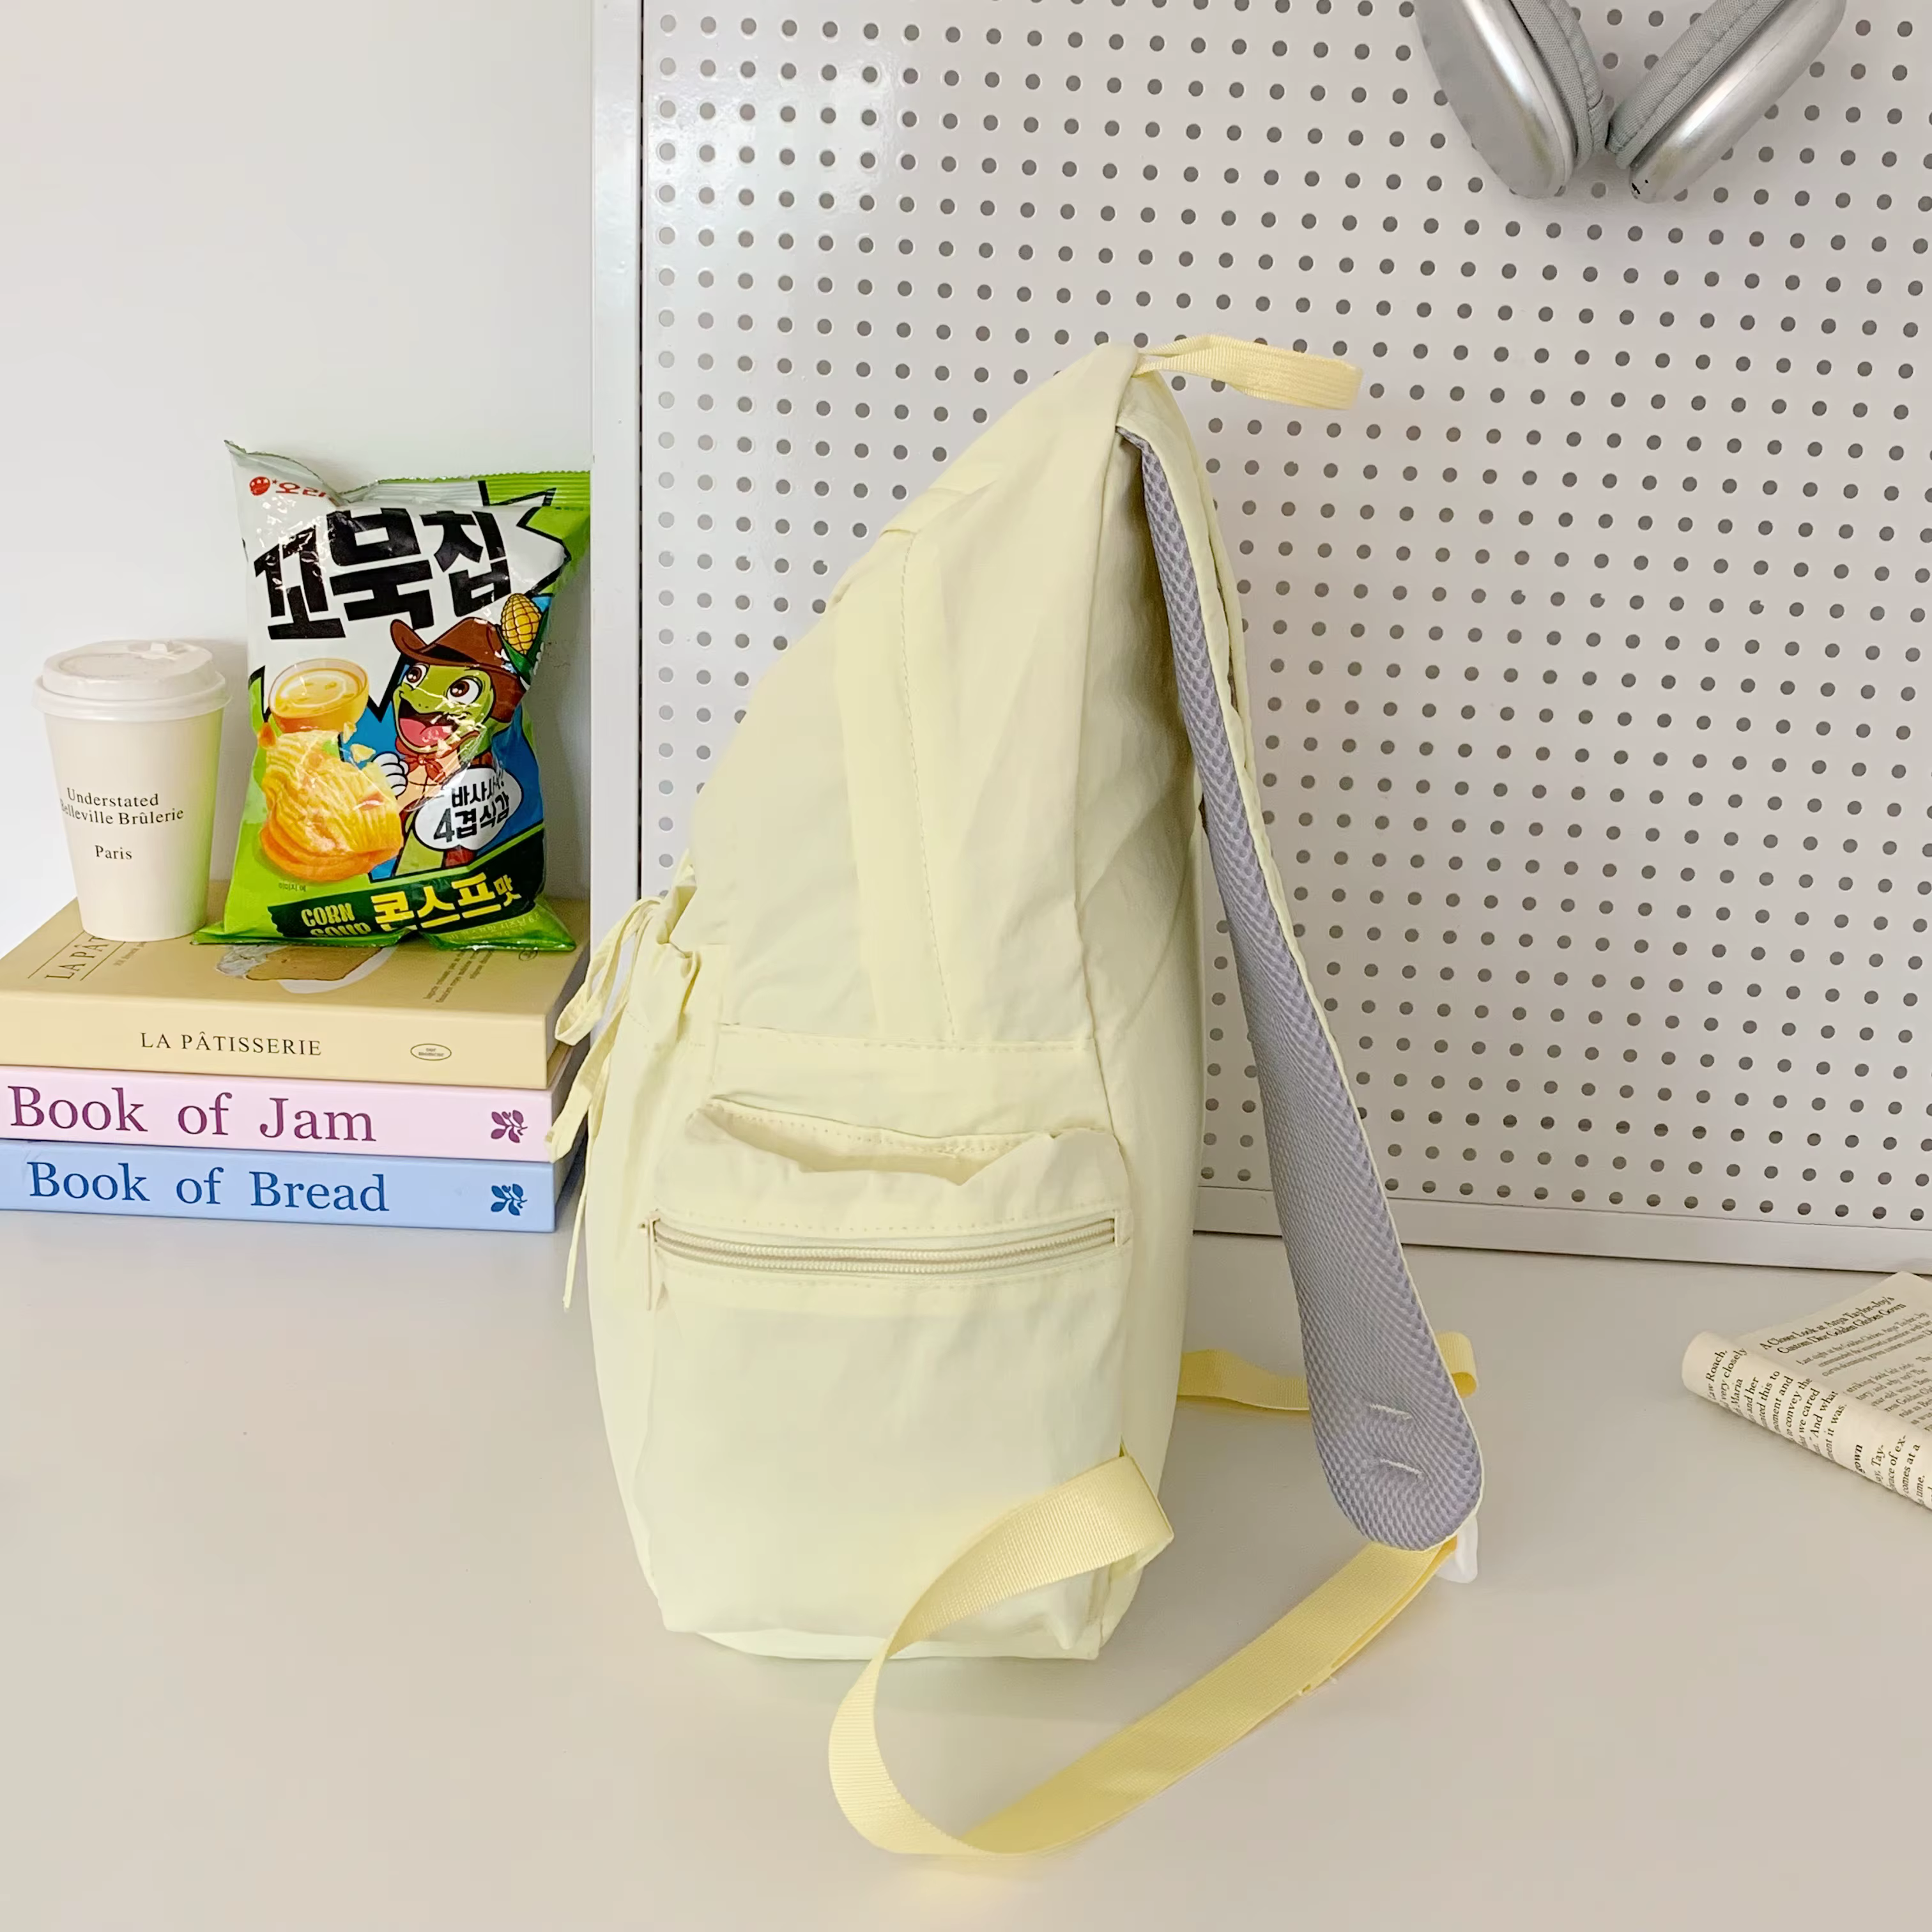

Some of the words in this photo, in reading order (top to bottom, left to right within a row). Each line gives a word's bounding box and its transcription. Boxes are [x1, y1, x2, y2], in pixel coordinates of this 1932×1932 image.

[254, 508, 512, 640] 꼬북칩
[66, 786, 159, 808] Understated
[118, 808, 184, 825] Brûlerie
[95, 845, 132, 860] Paris
[301, 903, 355, 927] CORN
[44, 963, 86, 979] LA
[140, 1032, 171, 1049] LA
[181, 1031, 322, 1056] PÂTISSERIE
[8, 1085, 148, 1132] Book
[177, 1092, 233, 1136] of
[259, 1097, 377, 1142] Jam
[27, 1162, 151, 1201] Book
[176, 1167, 224, 1205] of
[249, 1170, 390, 1212] Bread
[1706, 1350, 1728, 1382] Roach,
[1722, 1348, 1747, 1378] closely
[1745, 1377, 1759, 1395] her
[1759, 1383, 1773, 1401] this
[1770, 1370, 1781, 1380] to
[1779, 1376, 1794, 1396] and
[1786, 1391, 1802, 1428] convey
[1798, 1377, 1813, 1390] the
[1802, 1388, 1821, 1417] cared
[1810, 1413, 1823, 1438] And
[1820, 1391, 1839, 1411] what
[1799, 1420, 1806, 1433] we
[1824, 1428, 1835, 1437] it
[1871, 1445, 1885, 1466] Tay-
[1889, 1451, 1898, 1466] of
[1895, 1435, 1906, 1452] ex-
[1906, 1453, 1916, 1465] at
